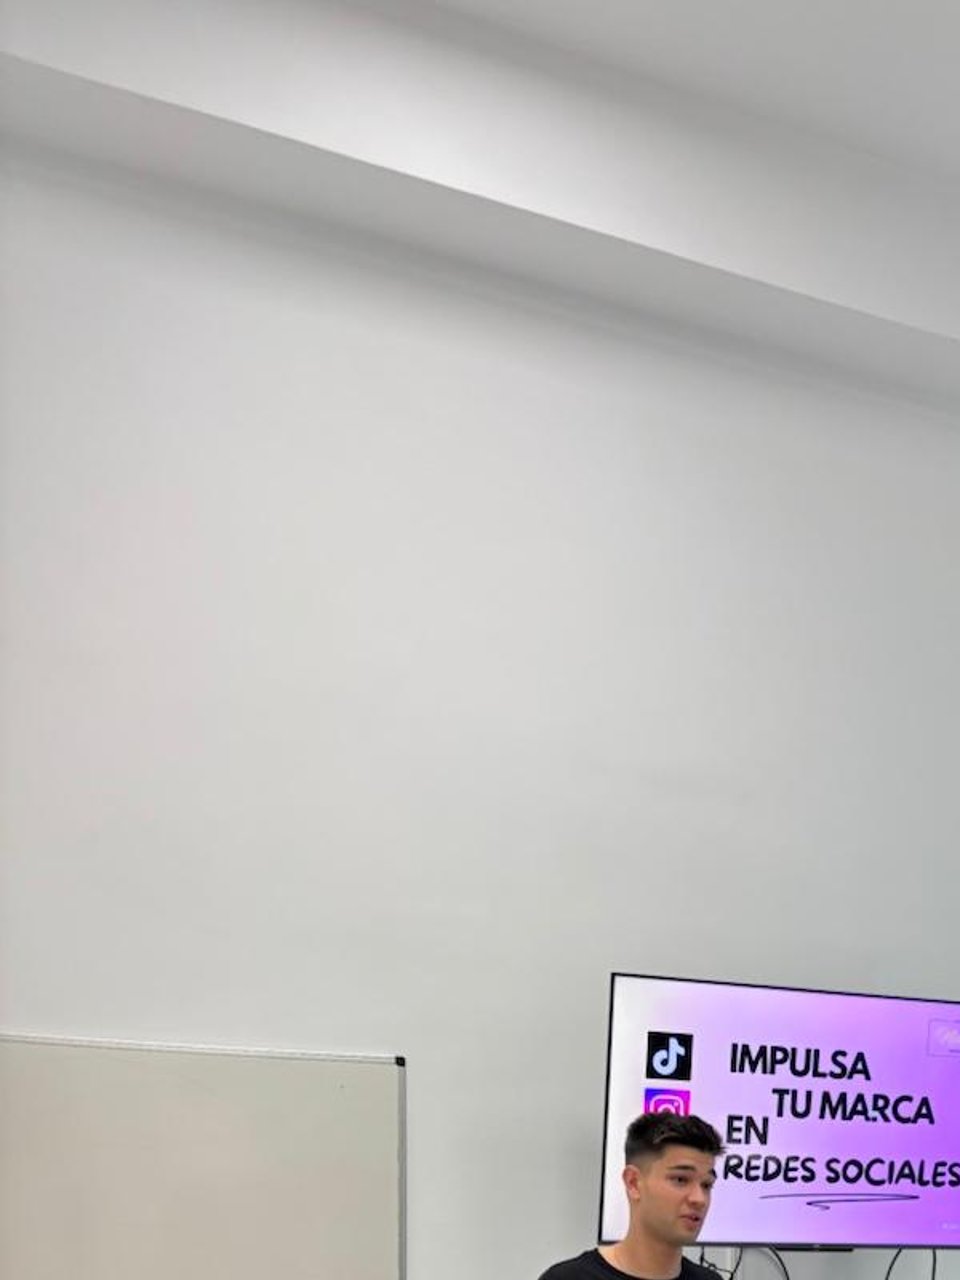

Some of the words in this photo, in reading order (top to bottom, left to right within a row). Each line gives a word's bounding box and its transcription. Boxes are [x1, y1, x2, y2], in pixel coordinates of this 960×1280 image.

[730, 1043, 871, 1081] IMPULSA
[772, 1088, 812, 1119] TU
[819, 1091, 935, 1125] MARCA
[726, 1114, 769, 1145] EN
[723, 1154, 817, 1183] REDES
